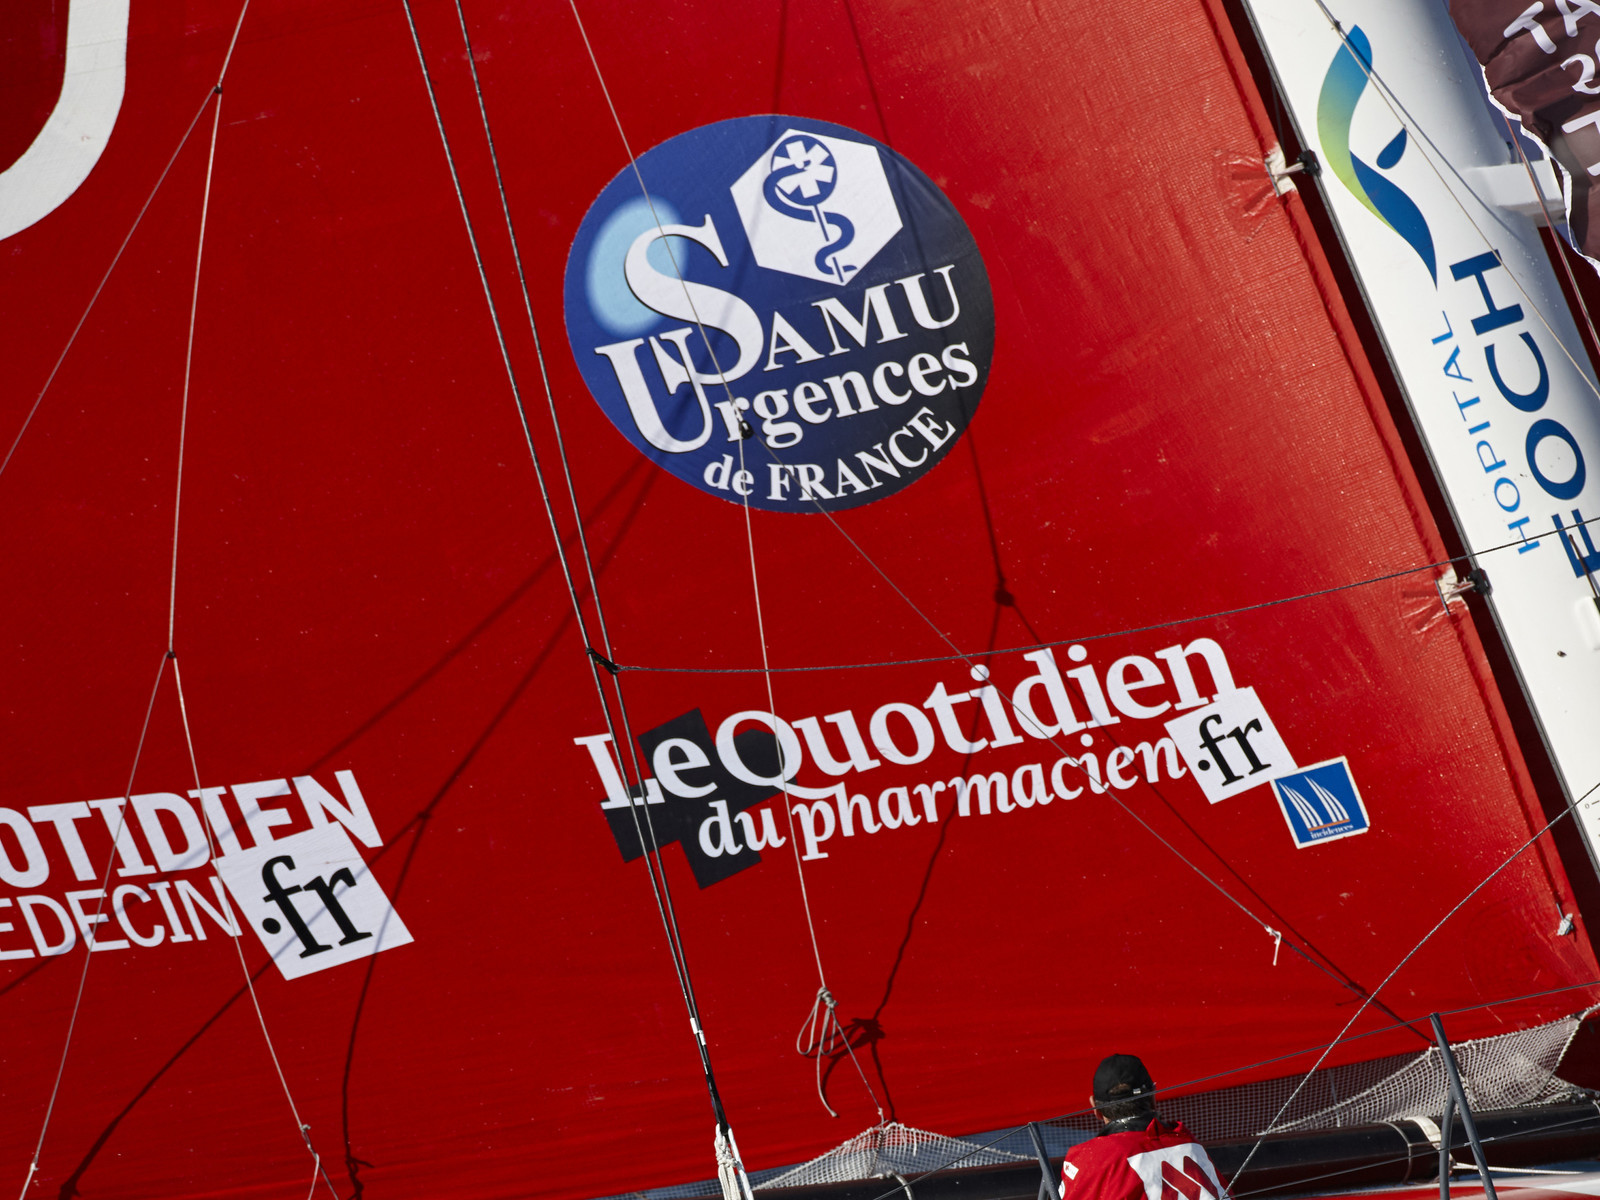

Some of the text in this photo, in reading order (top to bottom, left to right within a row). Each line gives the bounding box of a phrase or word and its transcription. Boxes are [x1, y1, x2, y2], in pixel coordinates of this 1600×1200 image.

[624, 213, 962, 386] SAMU
[594, 326, 980, 454] Urgences
[703, 406, 956, 502] de FRANCE
[1432, 310, 1540, 555] HOPITAL
[1449, 248, 1600, 578] FOCH
[698, 713, 1272, 861] du pharmacien .fr
[262, 855, 373, 959] .fr
